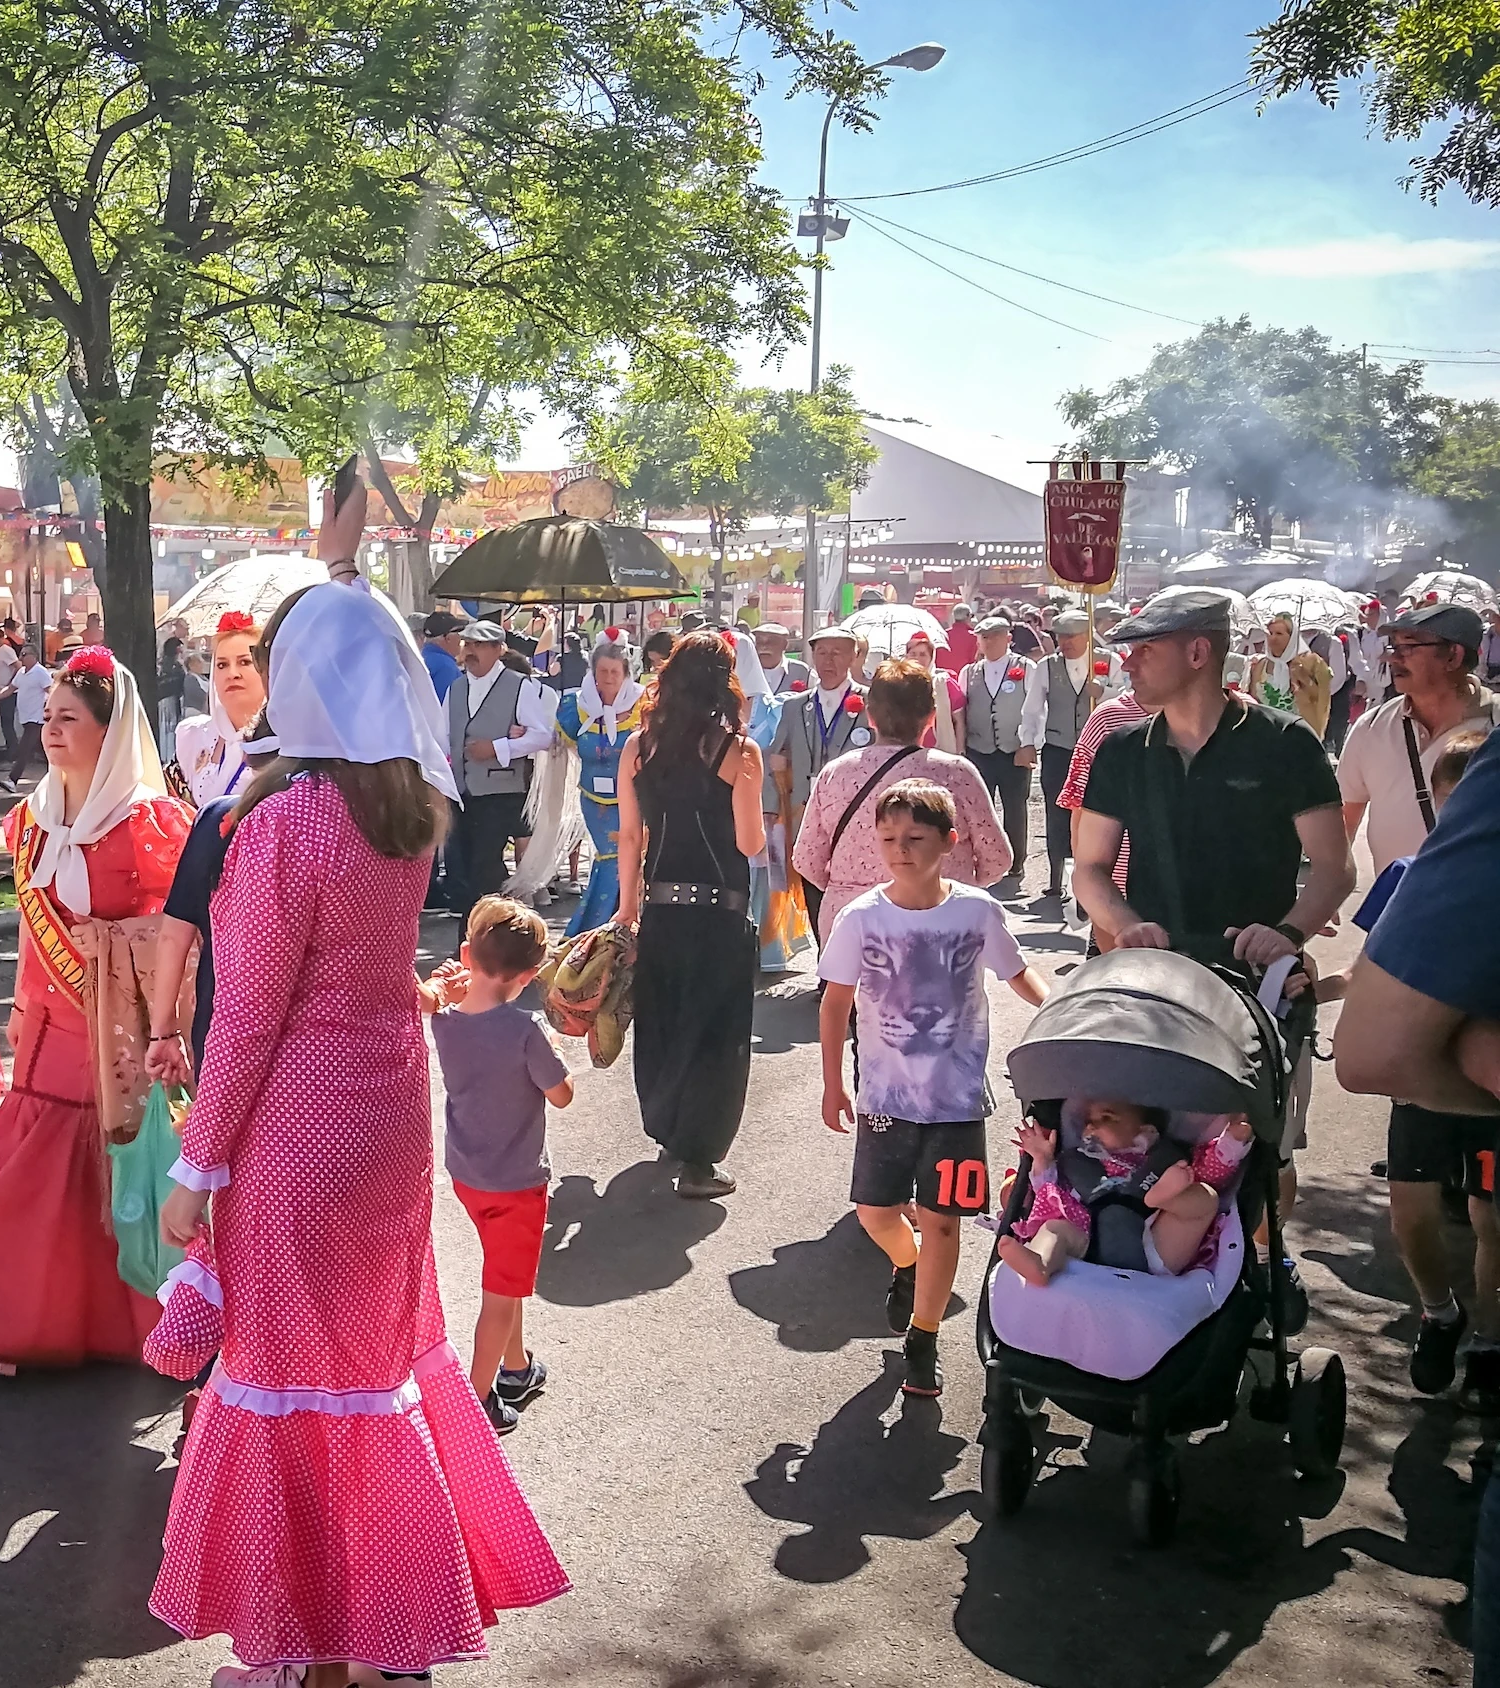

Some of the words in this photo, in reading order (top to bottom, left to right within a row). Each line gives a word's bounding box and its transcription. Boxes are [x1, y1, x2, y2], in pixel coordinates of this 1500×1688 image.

[1052, 484, 1091, 495] ASOC.
[1104, 484, 1120, 495] DE
[1050, 496, 1120, 510] CHULAPOS
[1078, 521, 1097, 534] DE
[1053, 531, 1117, 548] VALLECAS
[48, 938, 86, 996] MADR
[935, 1159, 986, 1208] 10
